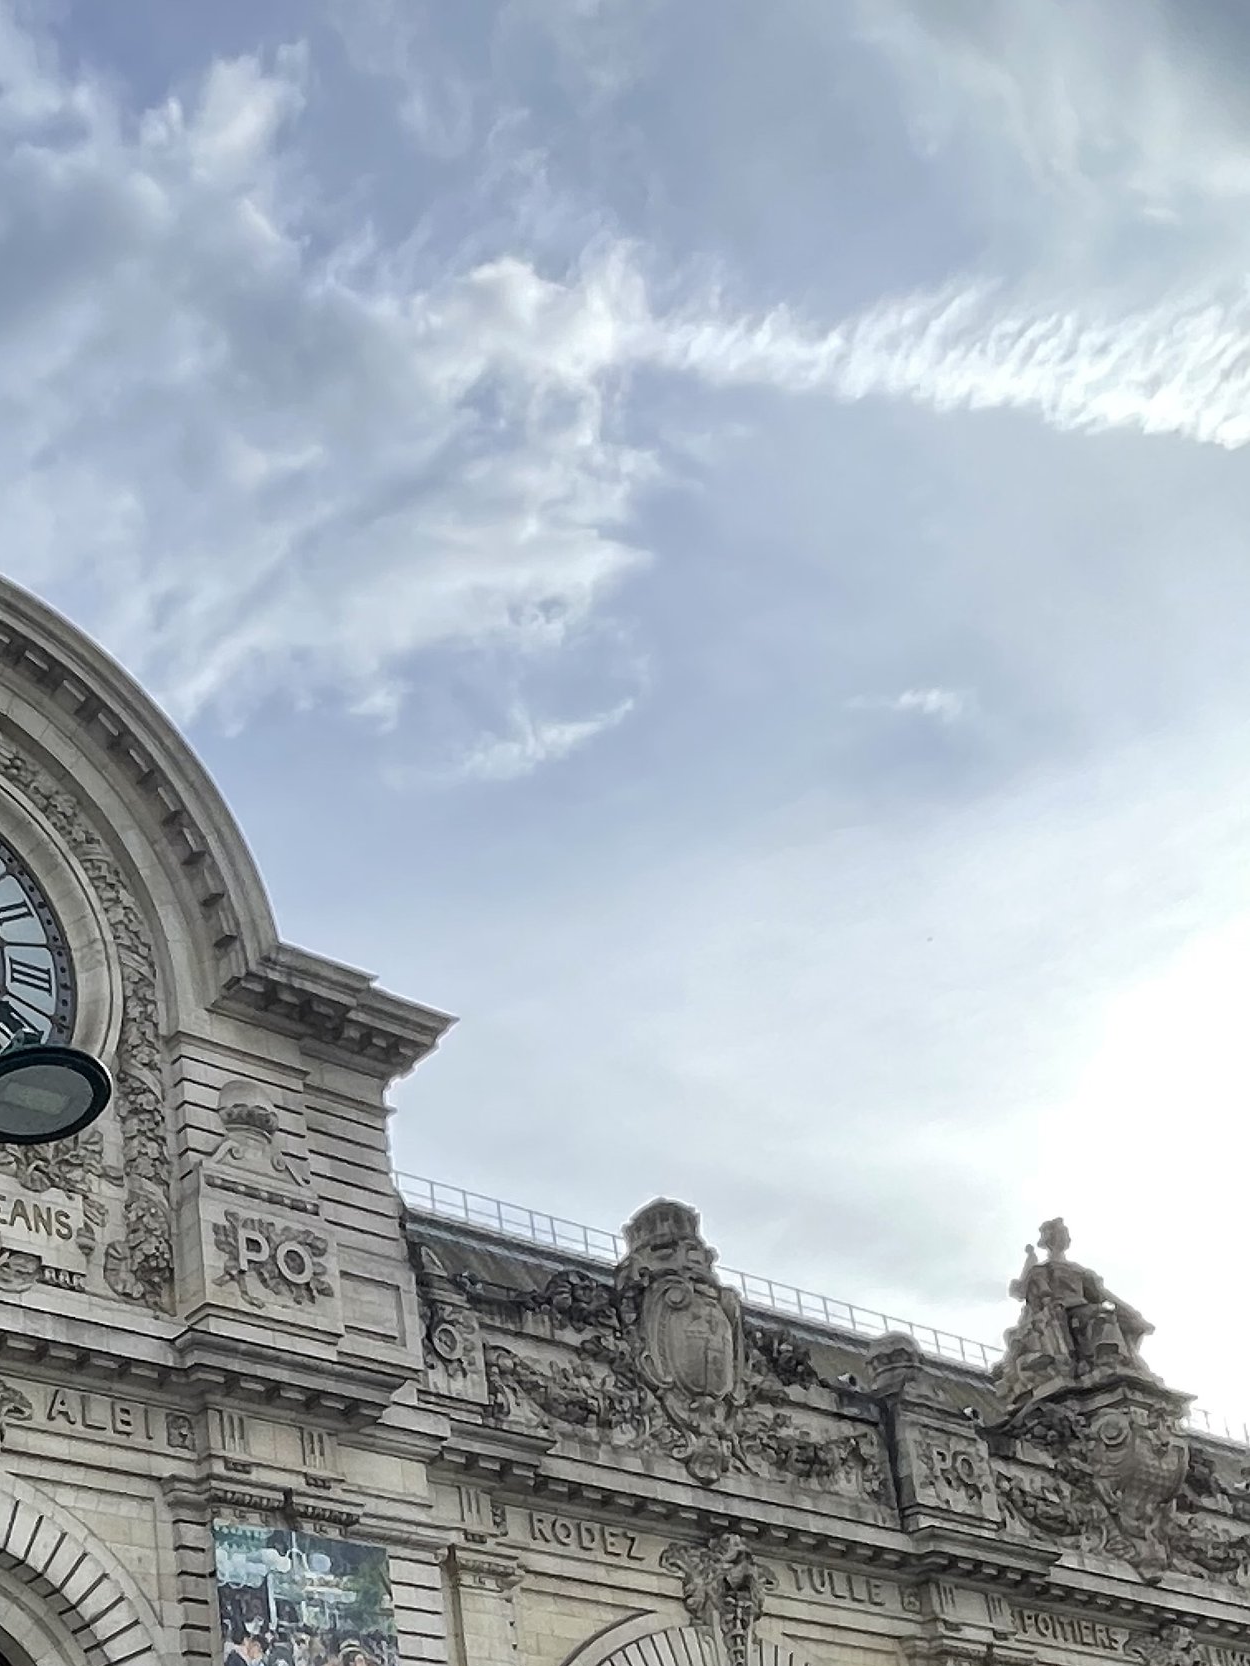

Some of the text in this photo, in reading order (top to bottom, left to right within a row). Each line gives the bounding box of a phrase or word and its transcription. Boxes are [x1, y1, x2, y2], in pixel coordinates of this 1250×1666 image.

[10, 957, 53, 997] III
[237, 1229, 314, 1285] PO
[47, 1388, 154, 1440] ALBI
[529, 1510, 647, 1562] RODEZ
[788, 1564, 886, 1606] TULLE
[1016, 1607, 1121, 1651] POITIERS
